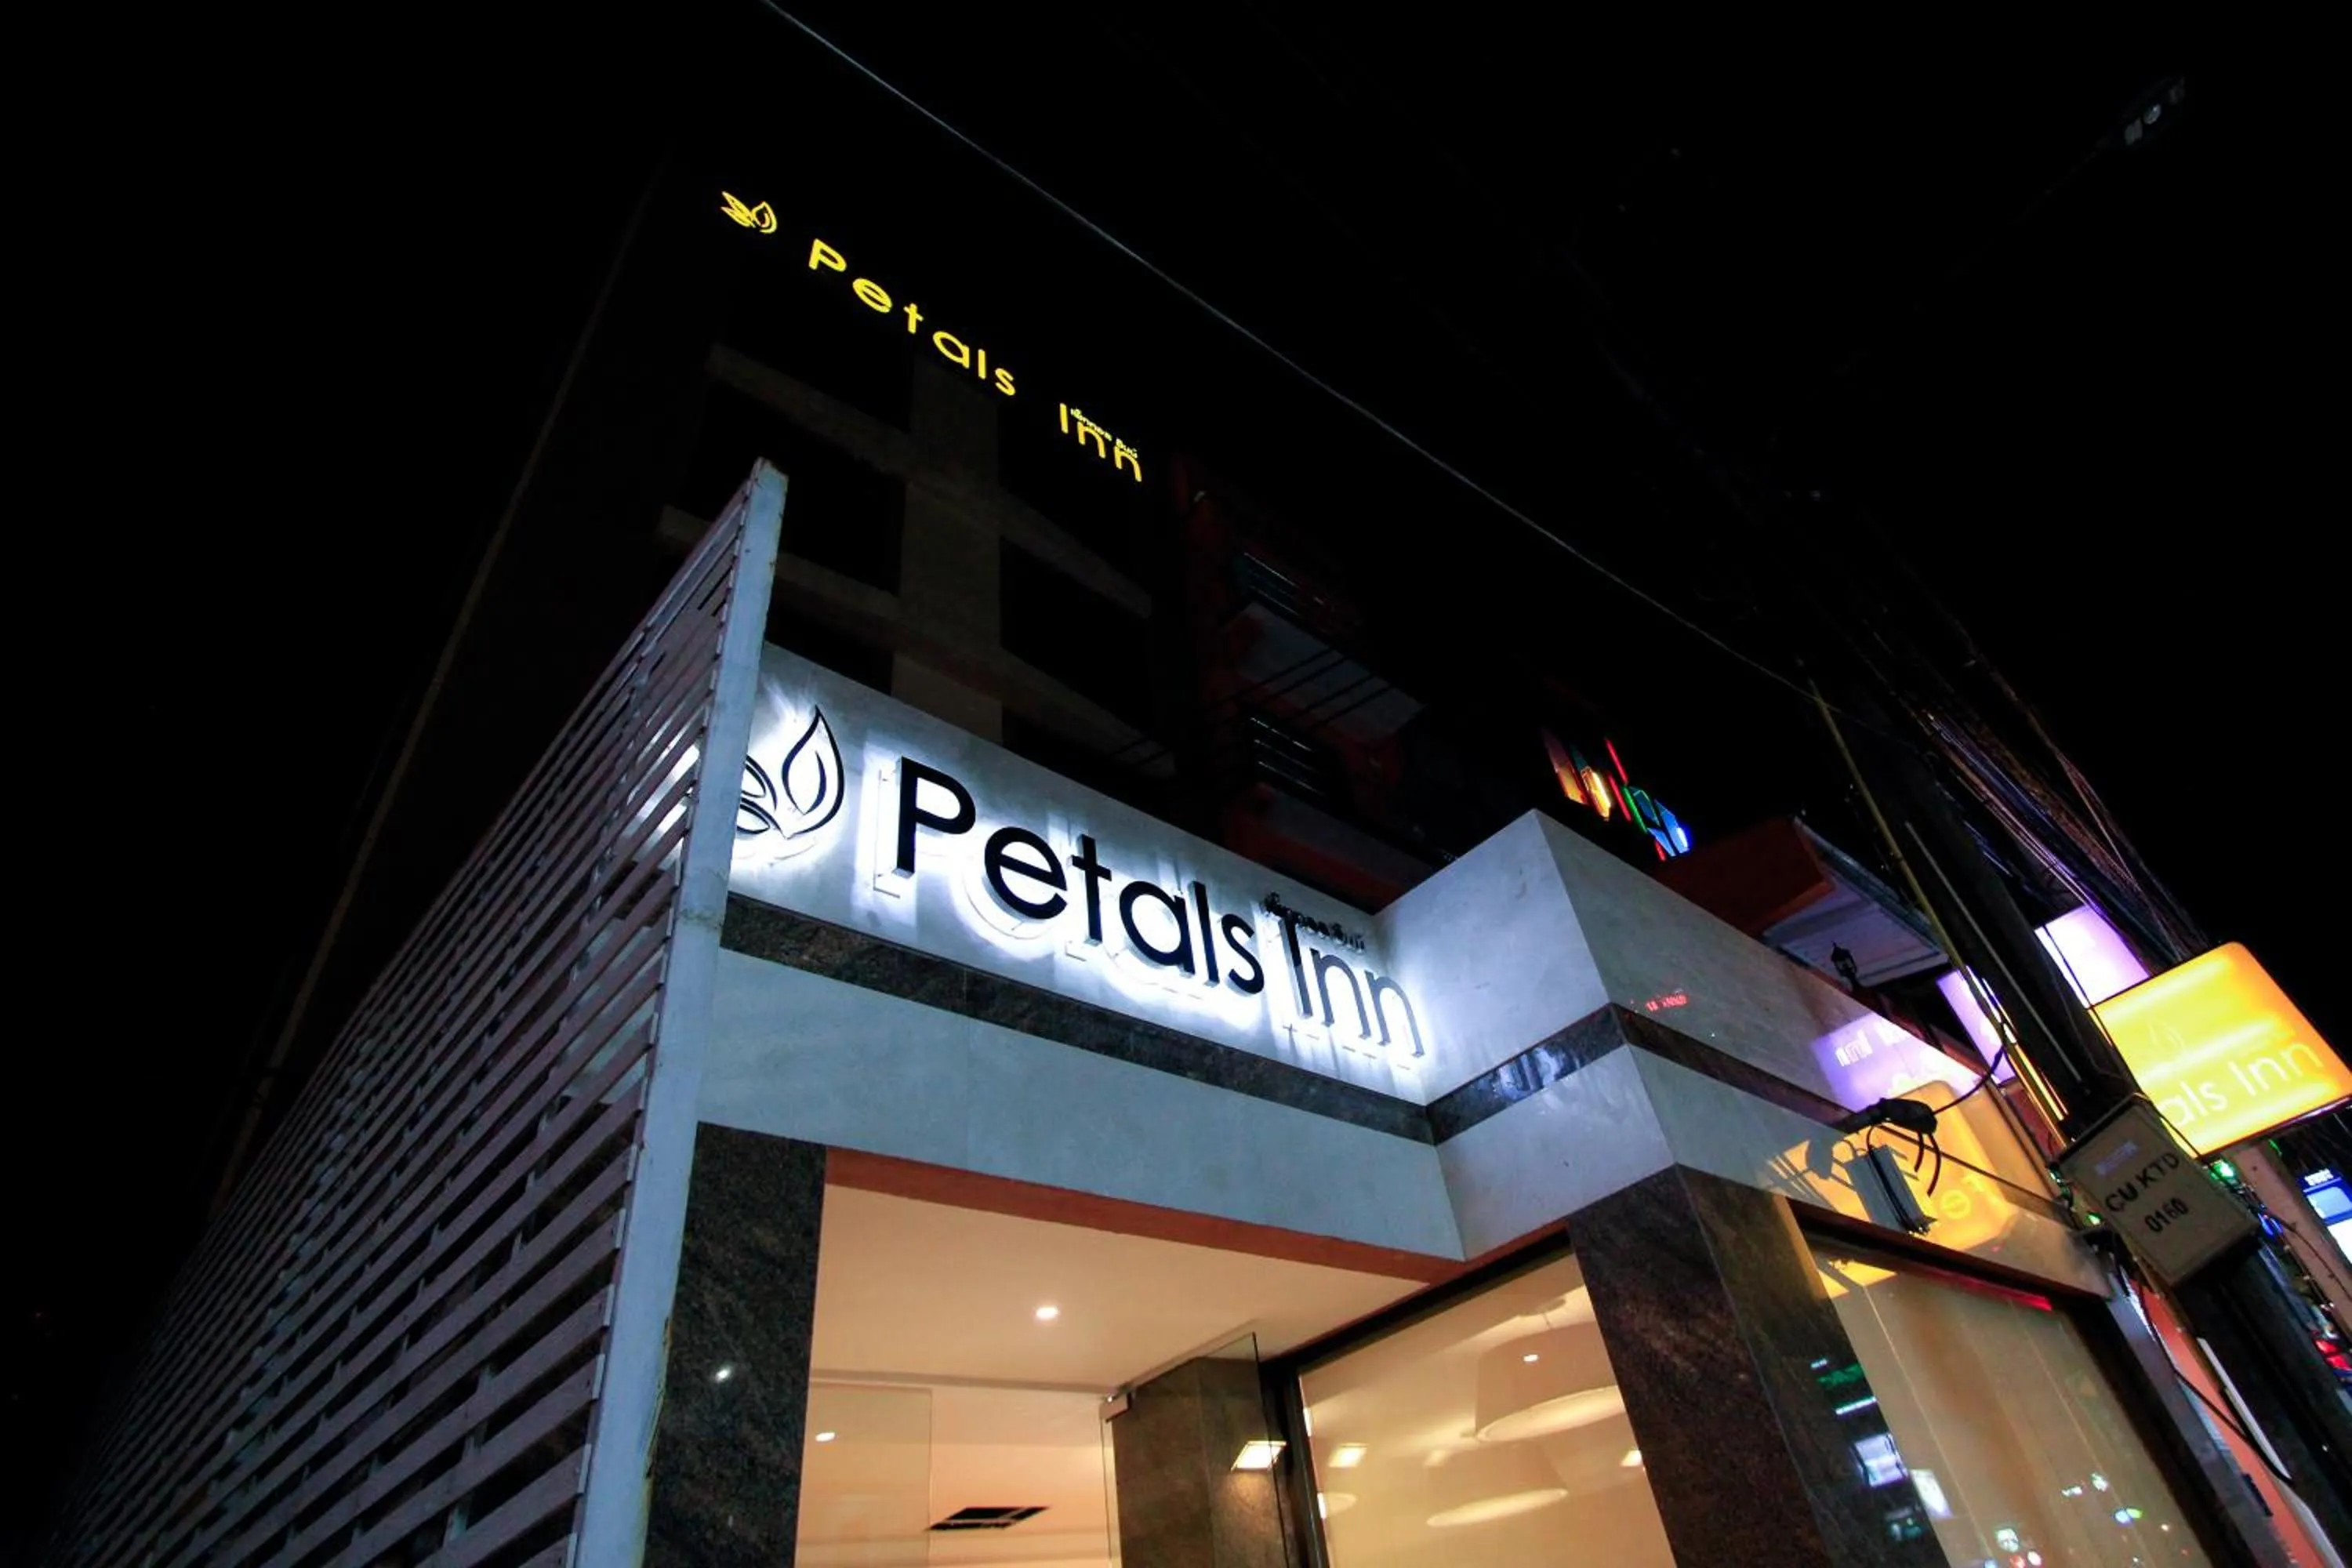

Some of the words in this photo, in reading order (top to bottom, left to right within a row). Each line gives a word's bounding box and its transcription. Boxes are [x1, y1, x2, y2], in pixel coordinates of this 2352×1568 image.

[808, 238, 1016, 396] Petals
[1059, 402, 1142, 482] Inn
[895, 757, 1265, 996] Petals
[1278, 911, 1425, 1058] Inn
[2155, 1080, 2228, 1127] als
[2227, 1043, 2324, 1097] Inn
